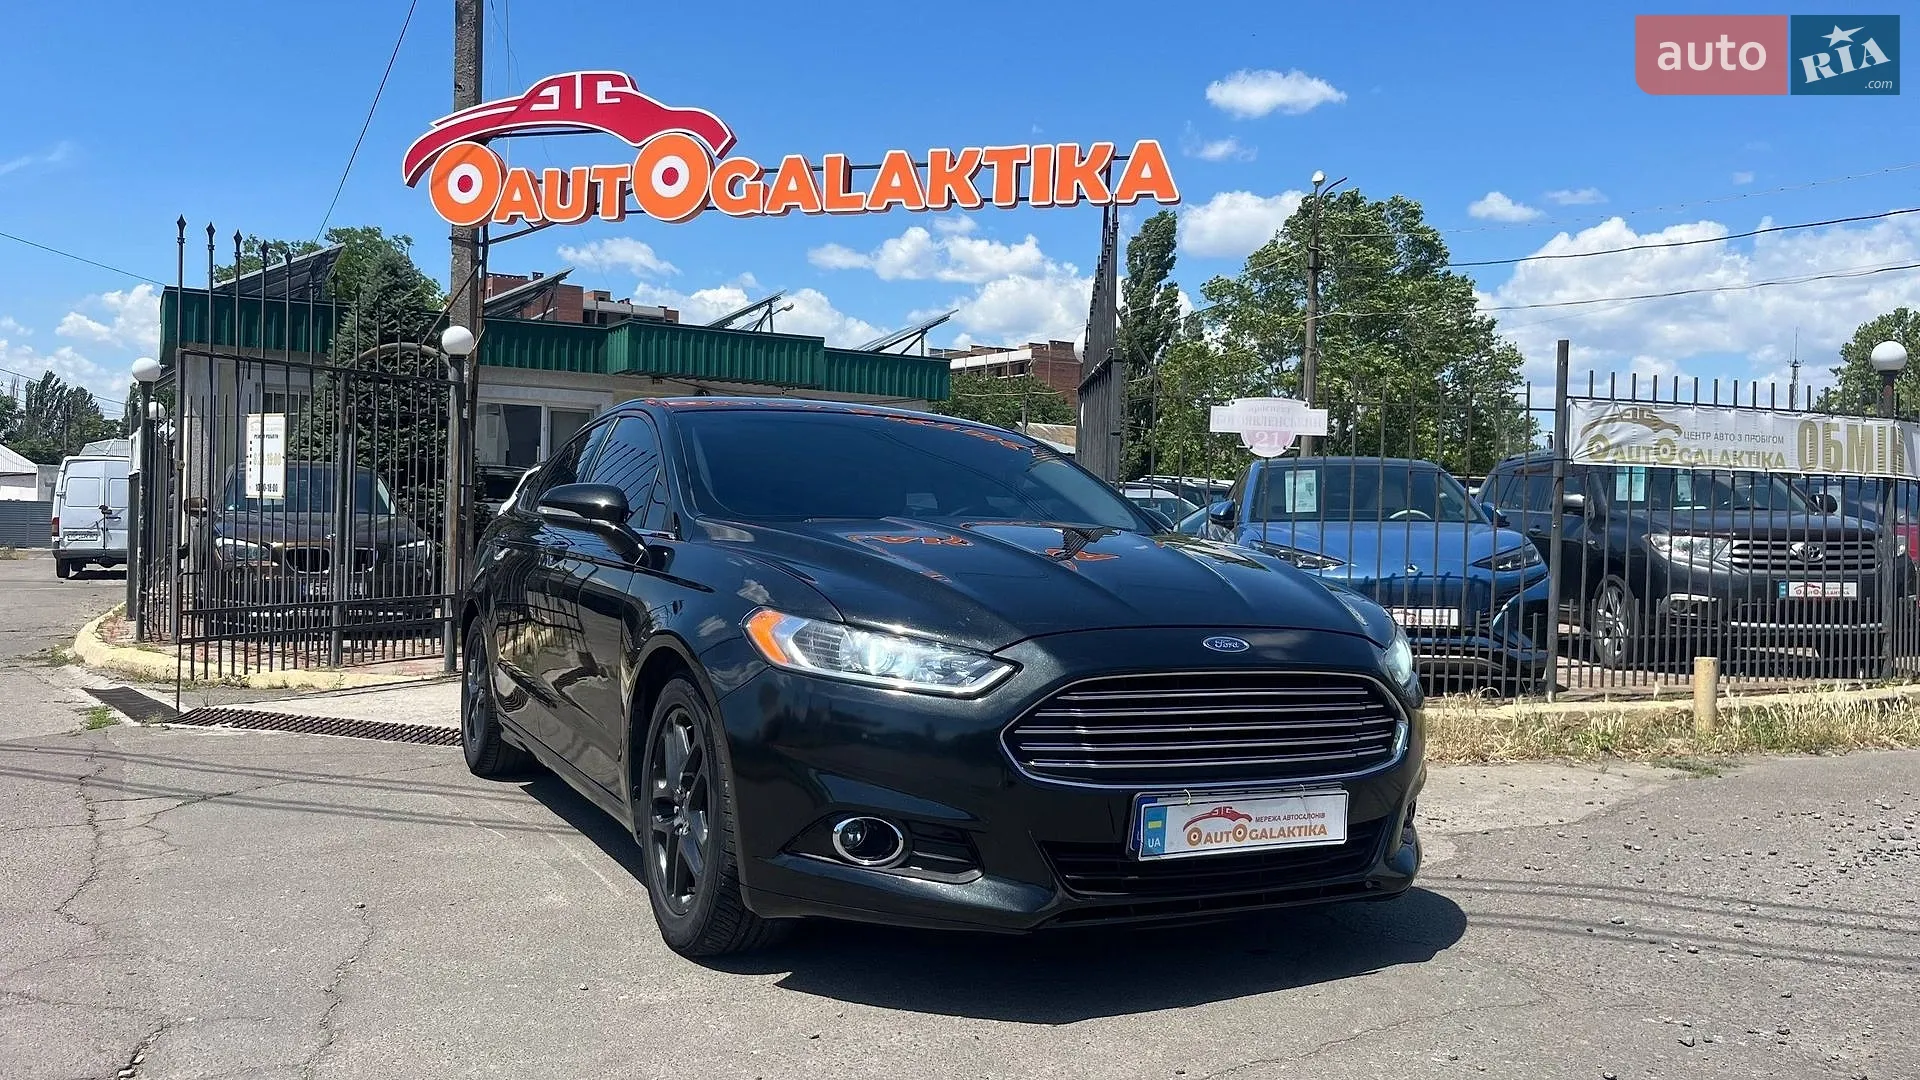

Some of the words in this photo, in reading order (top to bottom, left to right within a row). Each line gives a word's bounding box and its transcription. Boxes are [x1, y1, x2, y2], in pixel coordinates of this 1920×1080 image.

[1254, 431, 1280, 447] 21
[1683, 431, 1712, 441] ЦЕНТР
[1713, 432, 1736, 442] АВТО
[1214, 639, 1240, 649] Ford
[1255, 815, 1281, 823] МЕРЕЖА
[1148, 838, 1162, 848] UA
